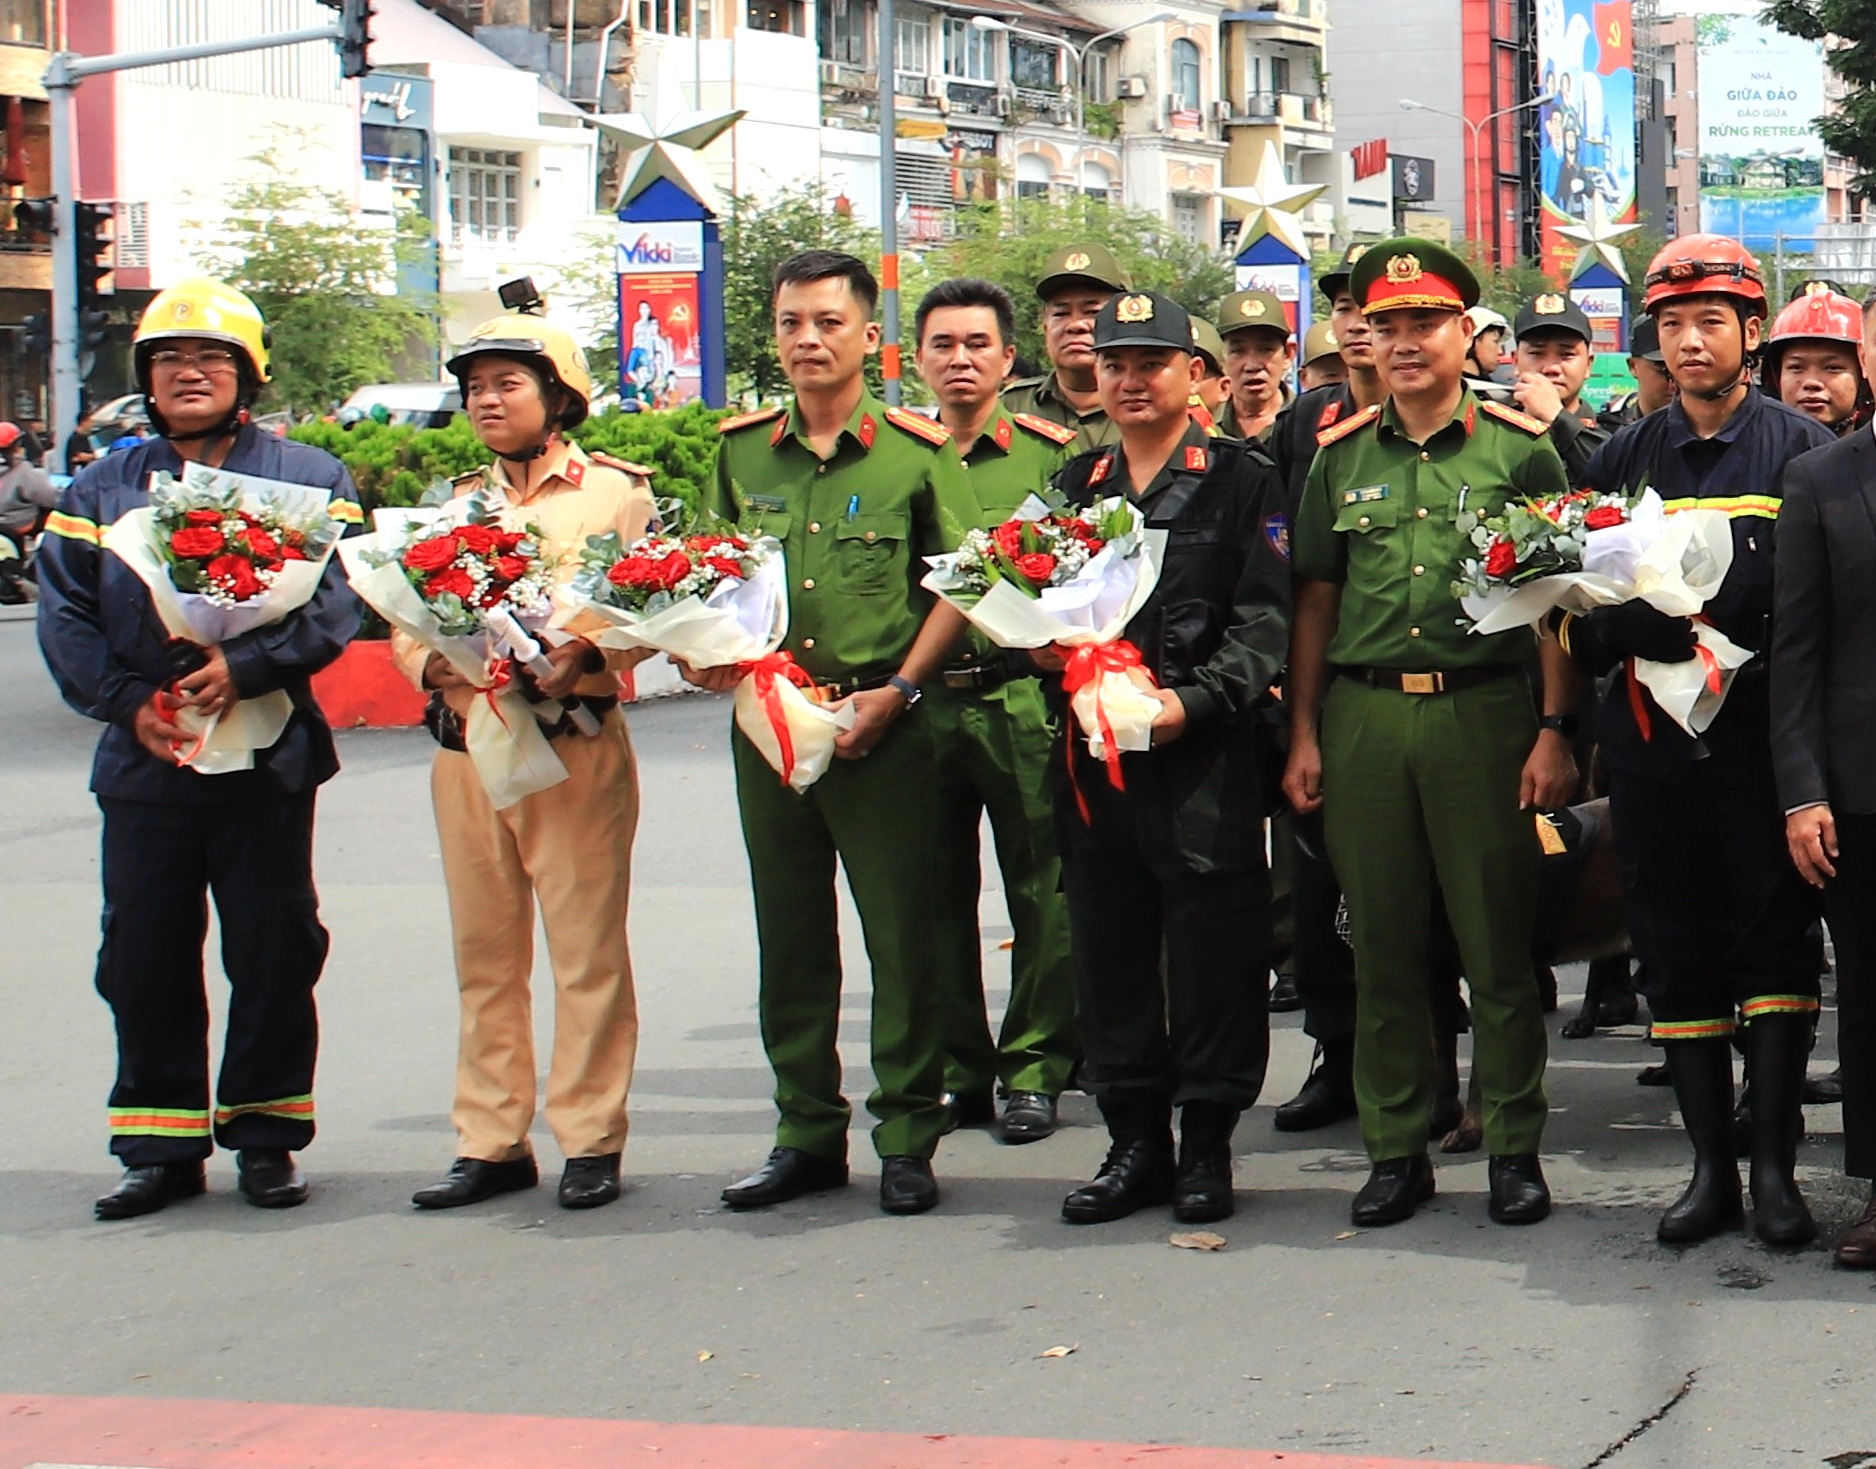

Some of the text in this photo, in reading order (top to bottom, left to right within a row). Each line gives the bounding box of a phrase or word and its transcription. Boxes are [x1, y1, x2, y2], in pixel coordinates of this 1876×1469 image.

[1727, 86, 1798, 101] GIỮA ĐẢO
[1737, 107, 1788, 118] ĐẢO GIỮA
[1709, 123, 1750, 137] RỪNG
[619, 232, 672, 264] Vikki
